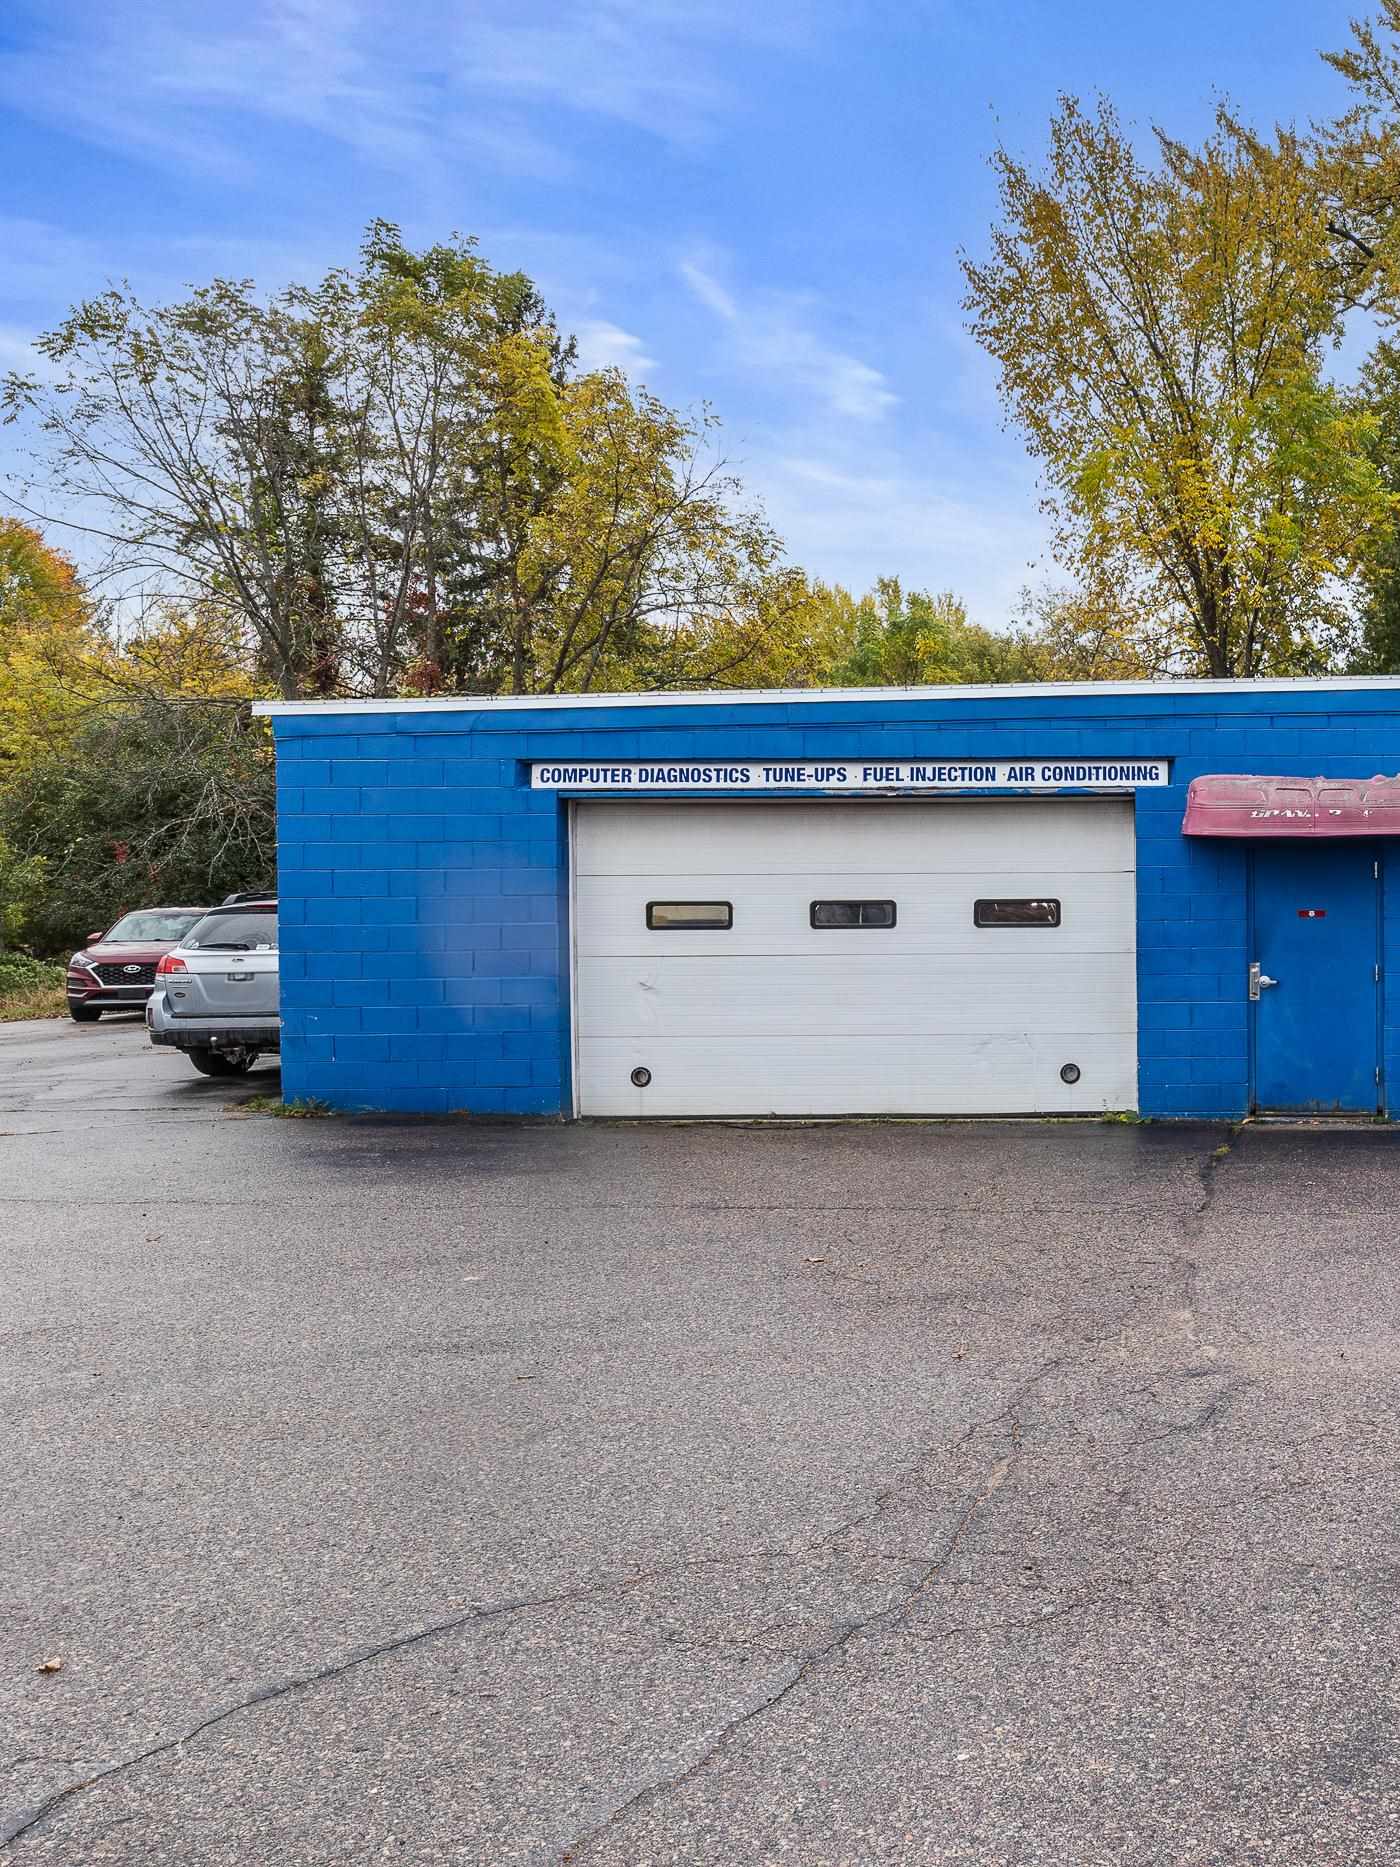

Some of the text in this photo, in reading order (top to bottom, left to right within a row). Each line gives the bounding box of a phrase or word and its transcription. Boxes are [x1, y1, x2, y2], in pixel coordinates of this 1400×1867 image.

[540, 765, 1160, 784] COMPUTER DIAGNOSTICS TUNE-UPS FUEL INJECTION AIR CONDITIONING
